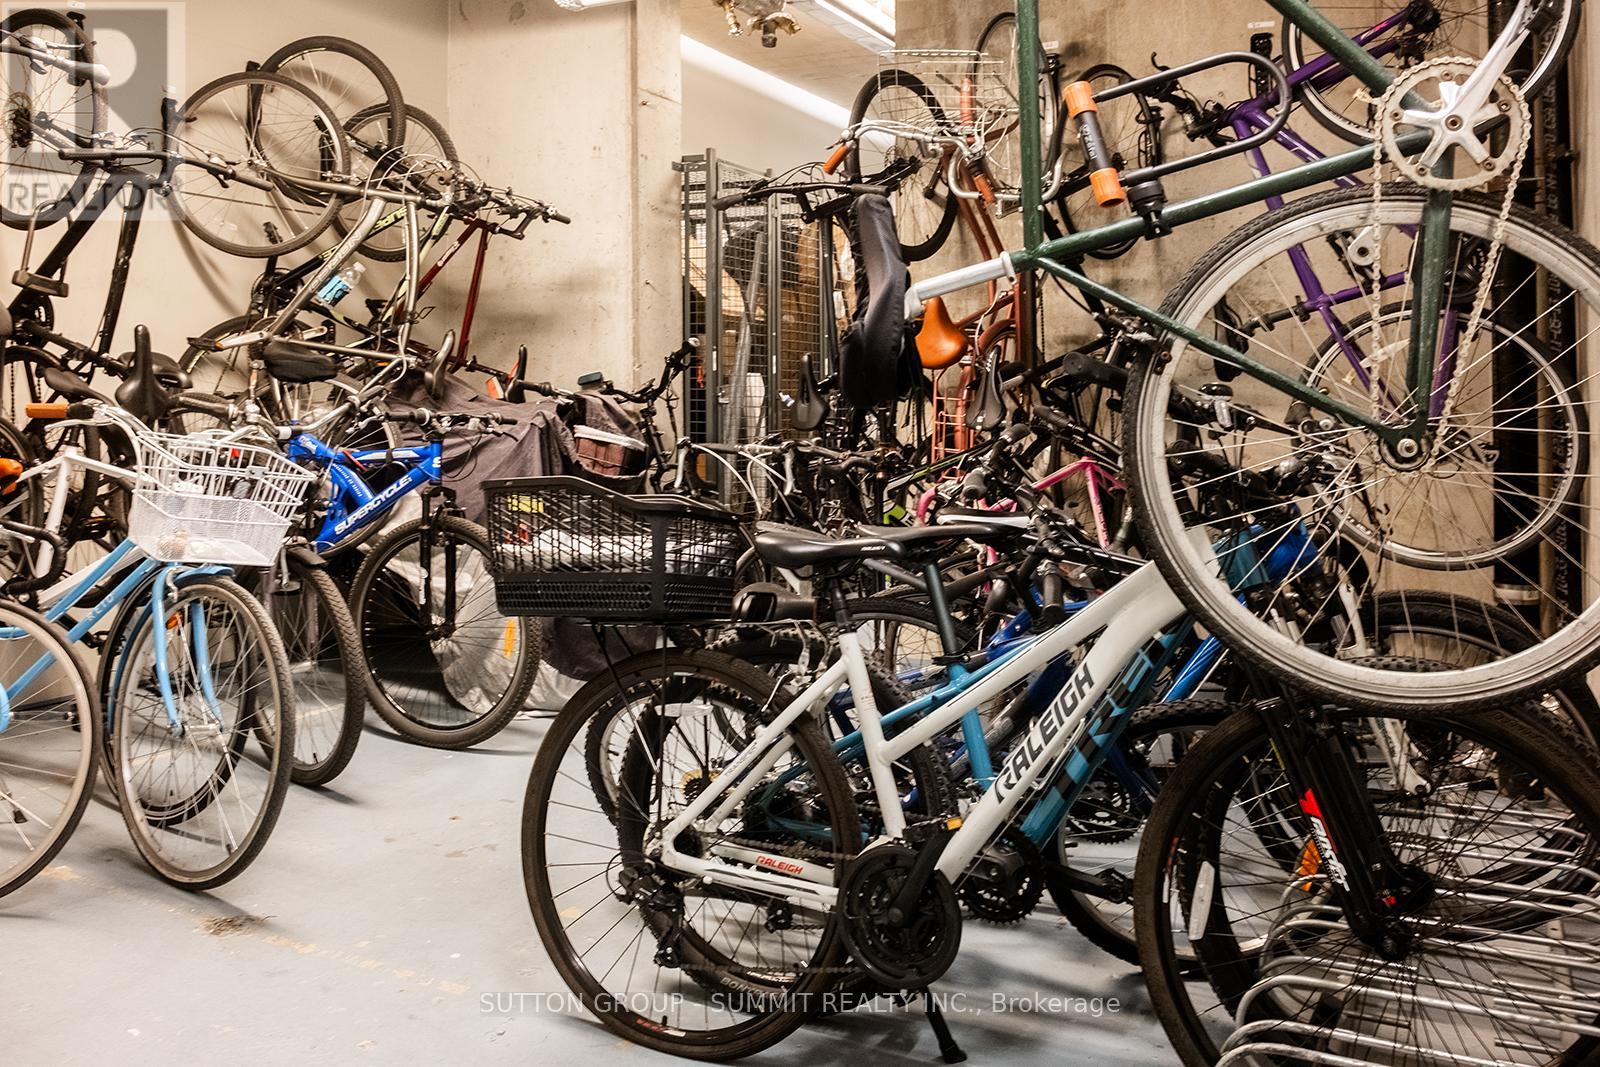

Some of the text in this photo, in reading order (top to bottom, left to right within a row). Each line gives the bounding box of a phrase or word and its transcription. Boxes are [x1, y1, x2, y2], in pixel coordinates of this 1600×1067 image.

[334, 475, 412, 535] SUPERCYCLE
[995, 663, 1095, 804] RALEIGH
[756, 855, 803, 874] RALEIGH
